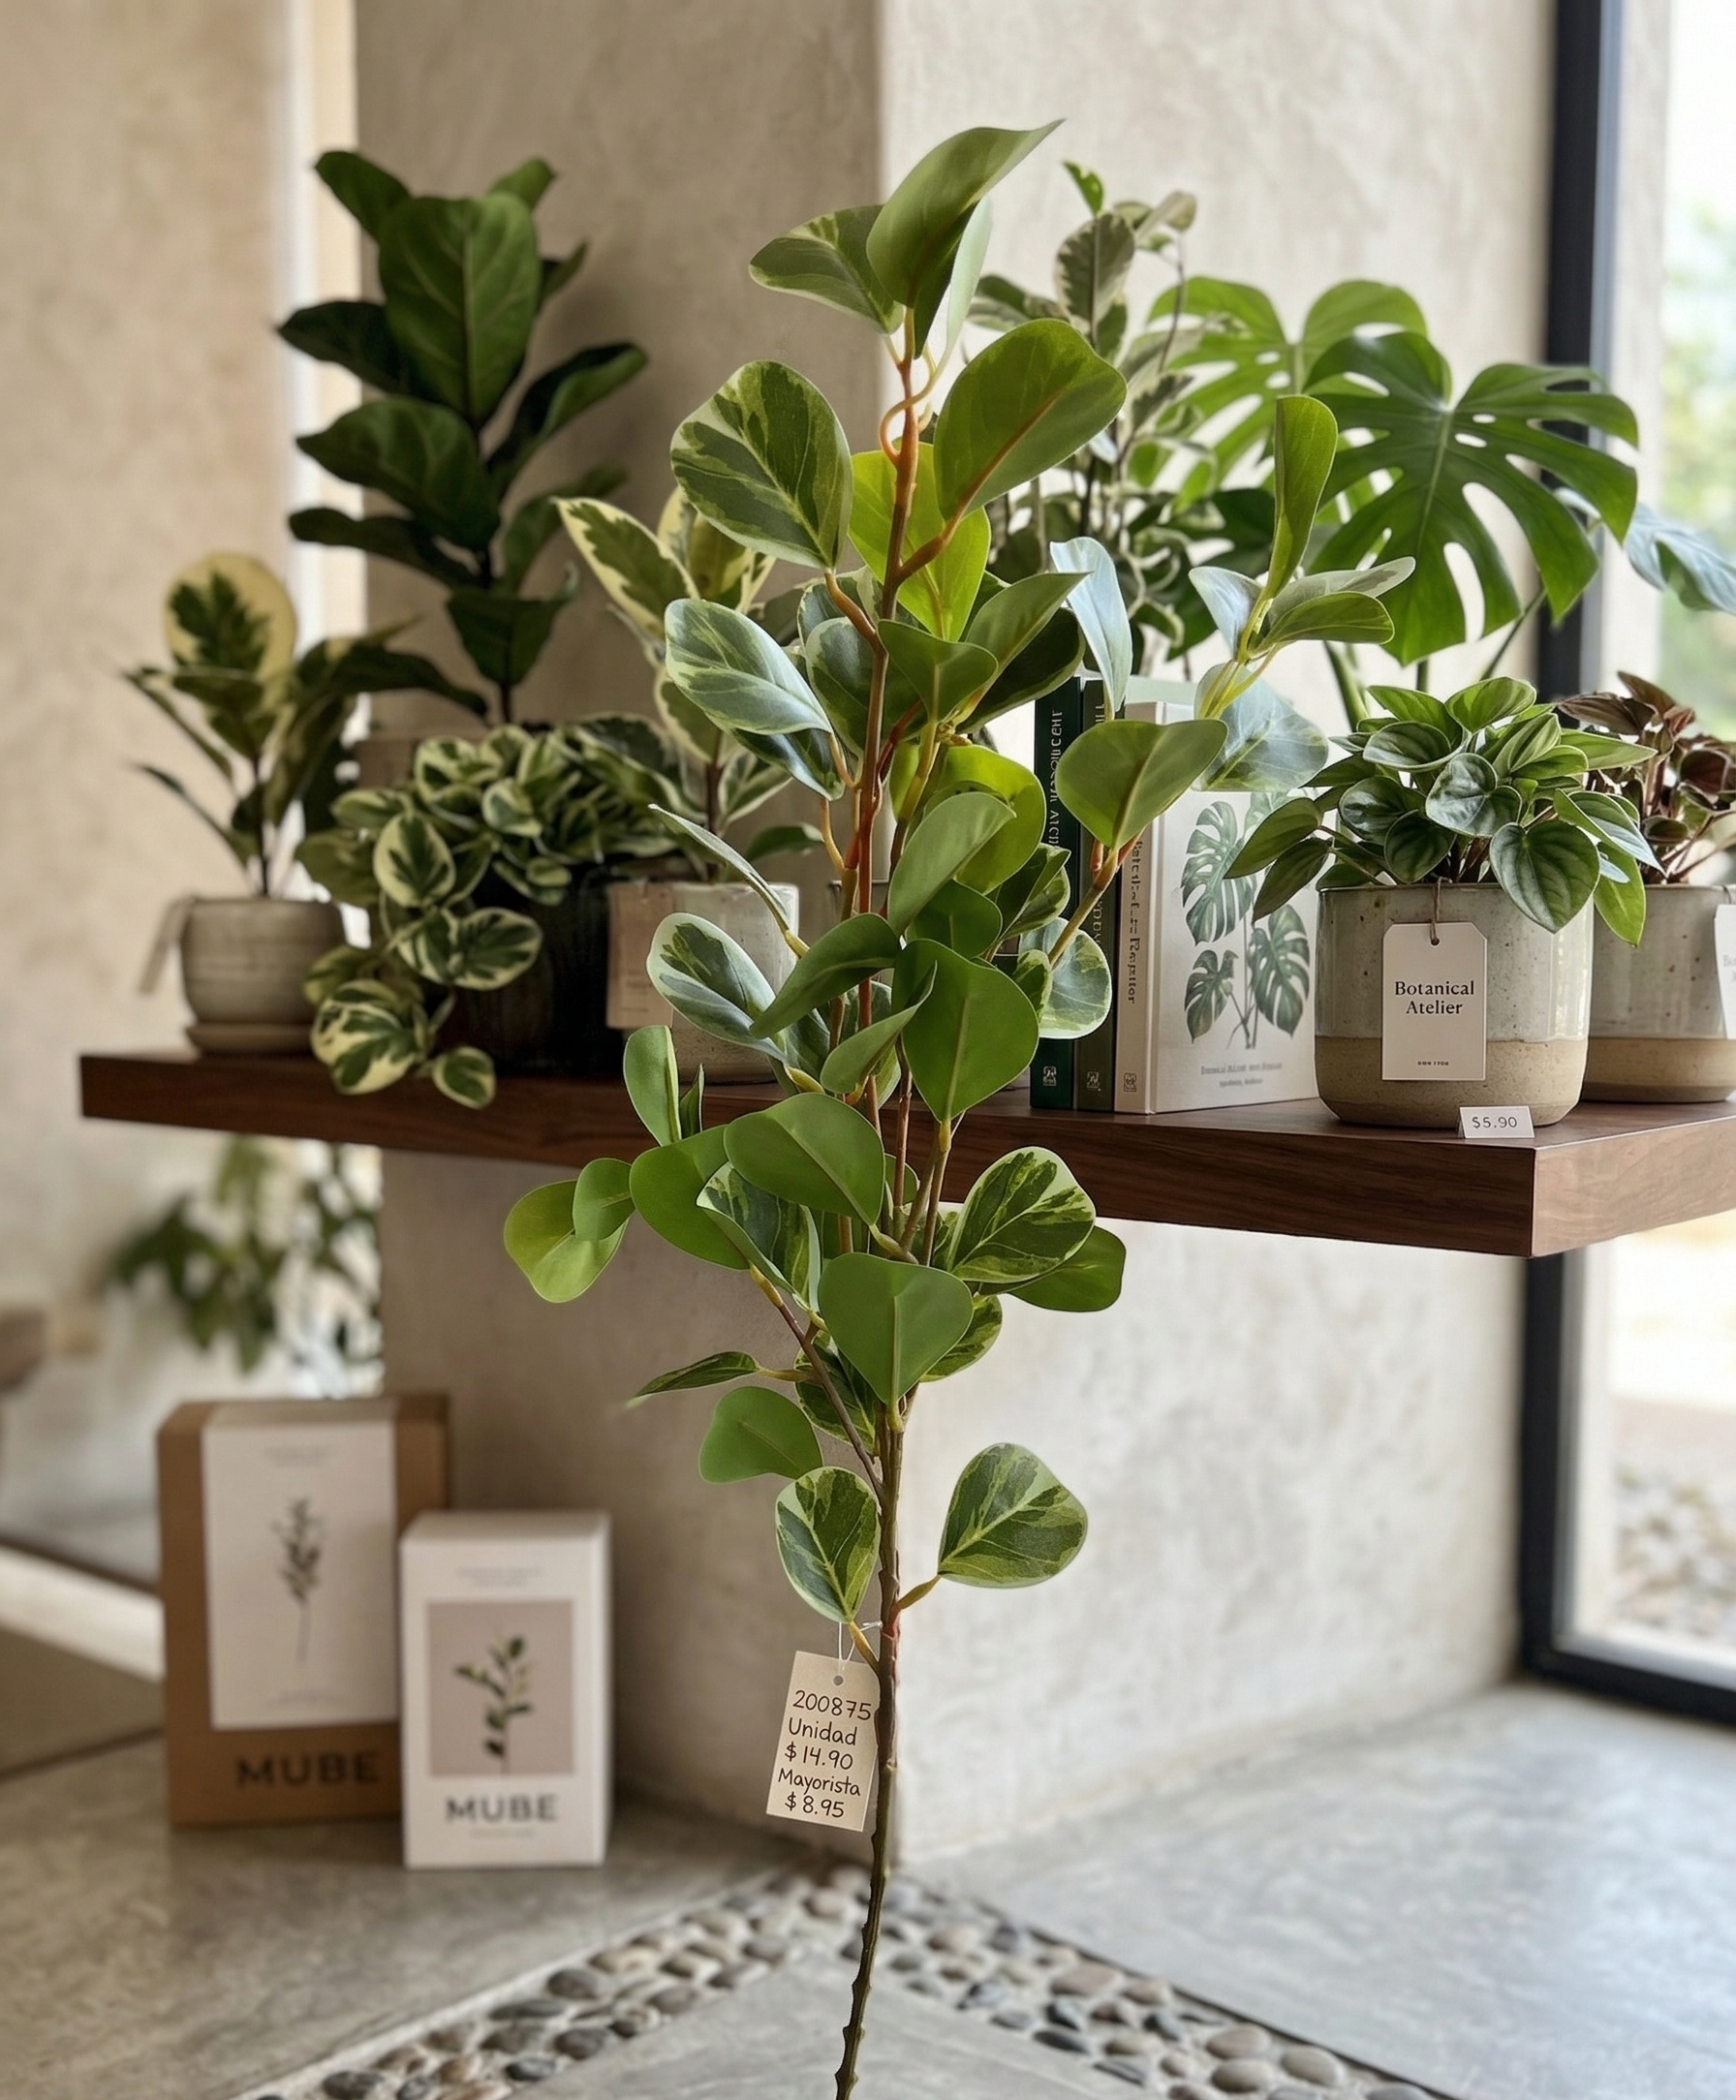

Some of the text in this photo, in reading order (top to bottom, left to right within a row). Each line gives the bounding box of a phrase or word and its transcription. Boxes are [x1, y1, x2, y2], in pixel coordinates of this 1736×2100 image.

[1394, 979, 1474, 996] Botanical
[1406, 1000, 1463, 1015] Atelier
[1472, 1116, 1518, 1130] $5.90
[792, 1689, 872, 1720] 200875
[789, 1716, 857, 1745] Unidad
[235, 1751, 382, 1788] MUBE
[778, 1768, 860, 1795] Mayorista
[446, 1794, 558, 1823] MUBE
